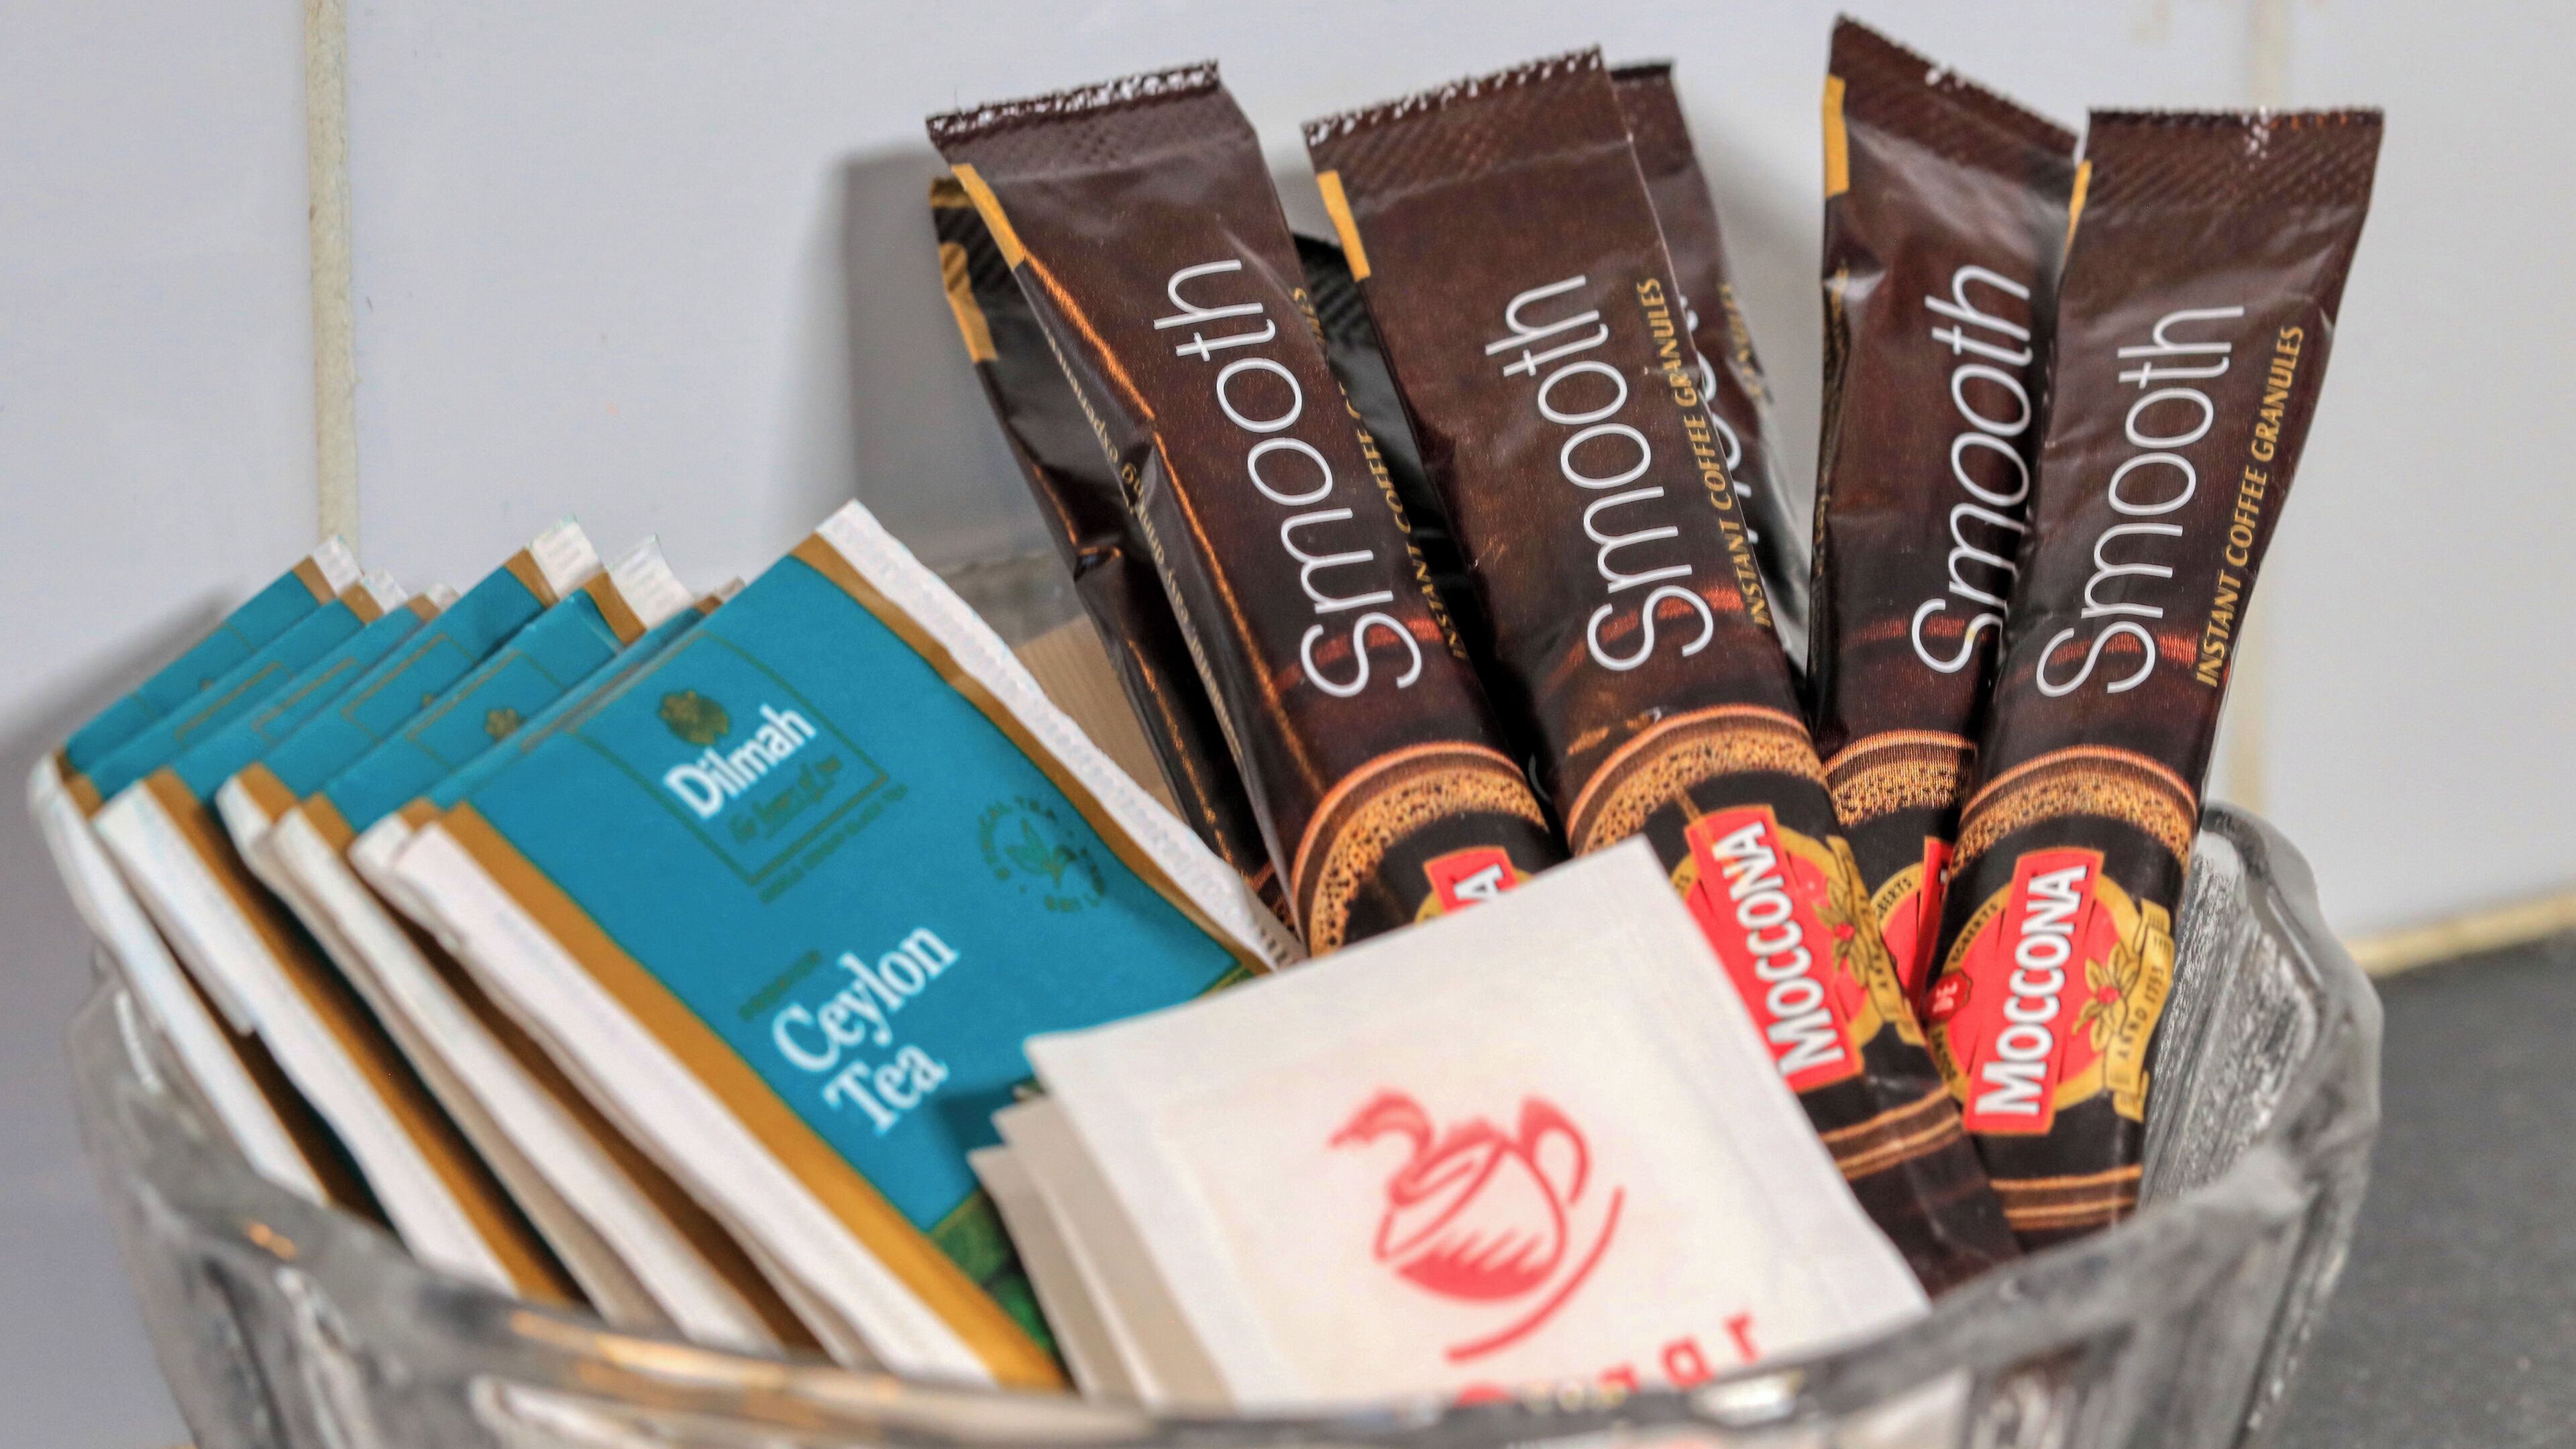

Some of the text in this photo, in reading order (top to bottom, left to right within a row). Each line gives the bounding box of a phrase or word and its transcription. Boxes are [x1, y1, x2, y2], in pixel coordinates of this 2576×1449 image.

[1637, 278, 1699, 407] GRANULES
[1684, 414, 1733, 510] COFFEE
[1153, 259, 1423, 699] Smooth
[1485, 274, 1713, 671] Smooth
[1719, 517, 1771, 627] INSTANT
[1911, 264, 2032, 674] Smooth
[2036, 306, 2245, 697] Smooth
[2196, 326, 2304, 688] INSTANT COFFEE GRANULES
[664, 704, 815, 818] Dilmah
[771, 926, 959, 1072] Ceylon
[1713, 820, 1845, 1075] MOCCONA
[1975, 865, 2088, 1116] MOCCONA
[823, 1044, 947, 1134] Tea
